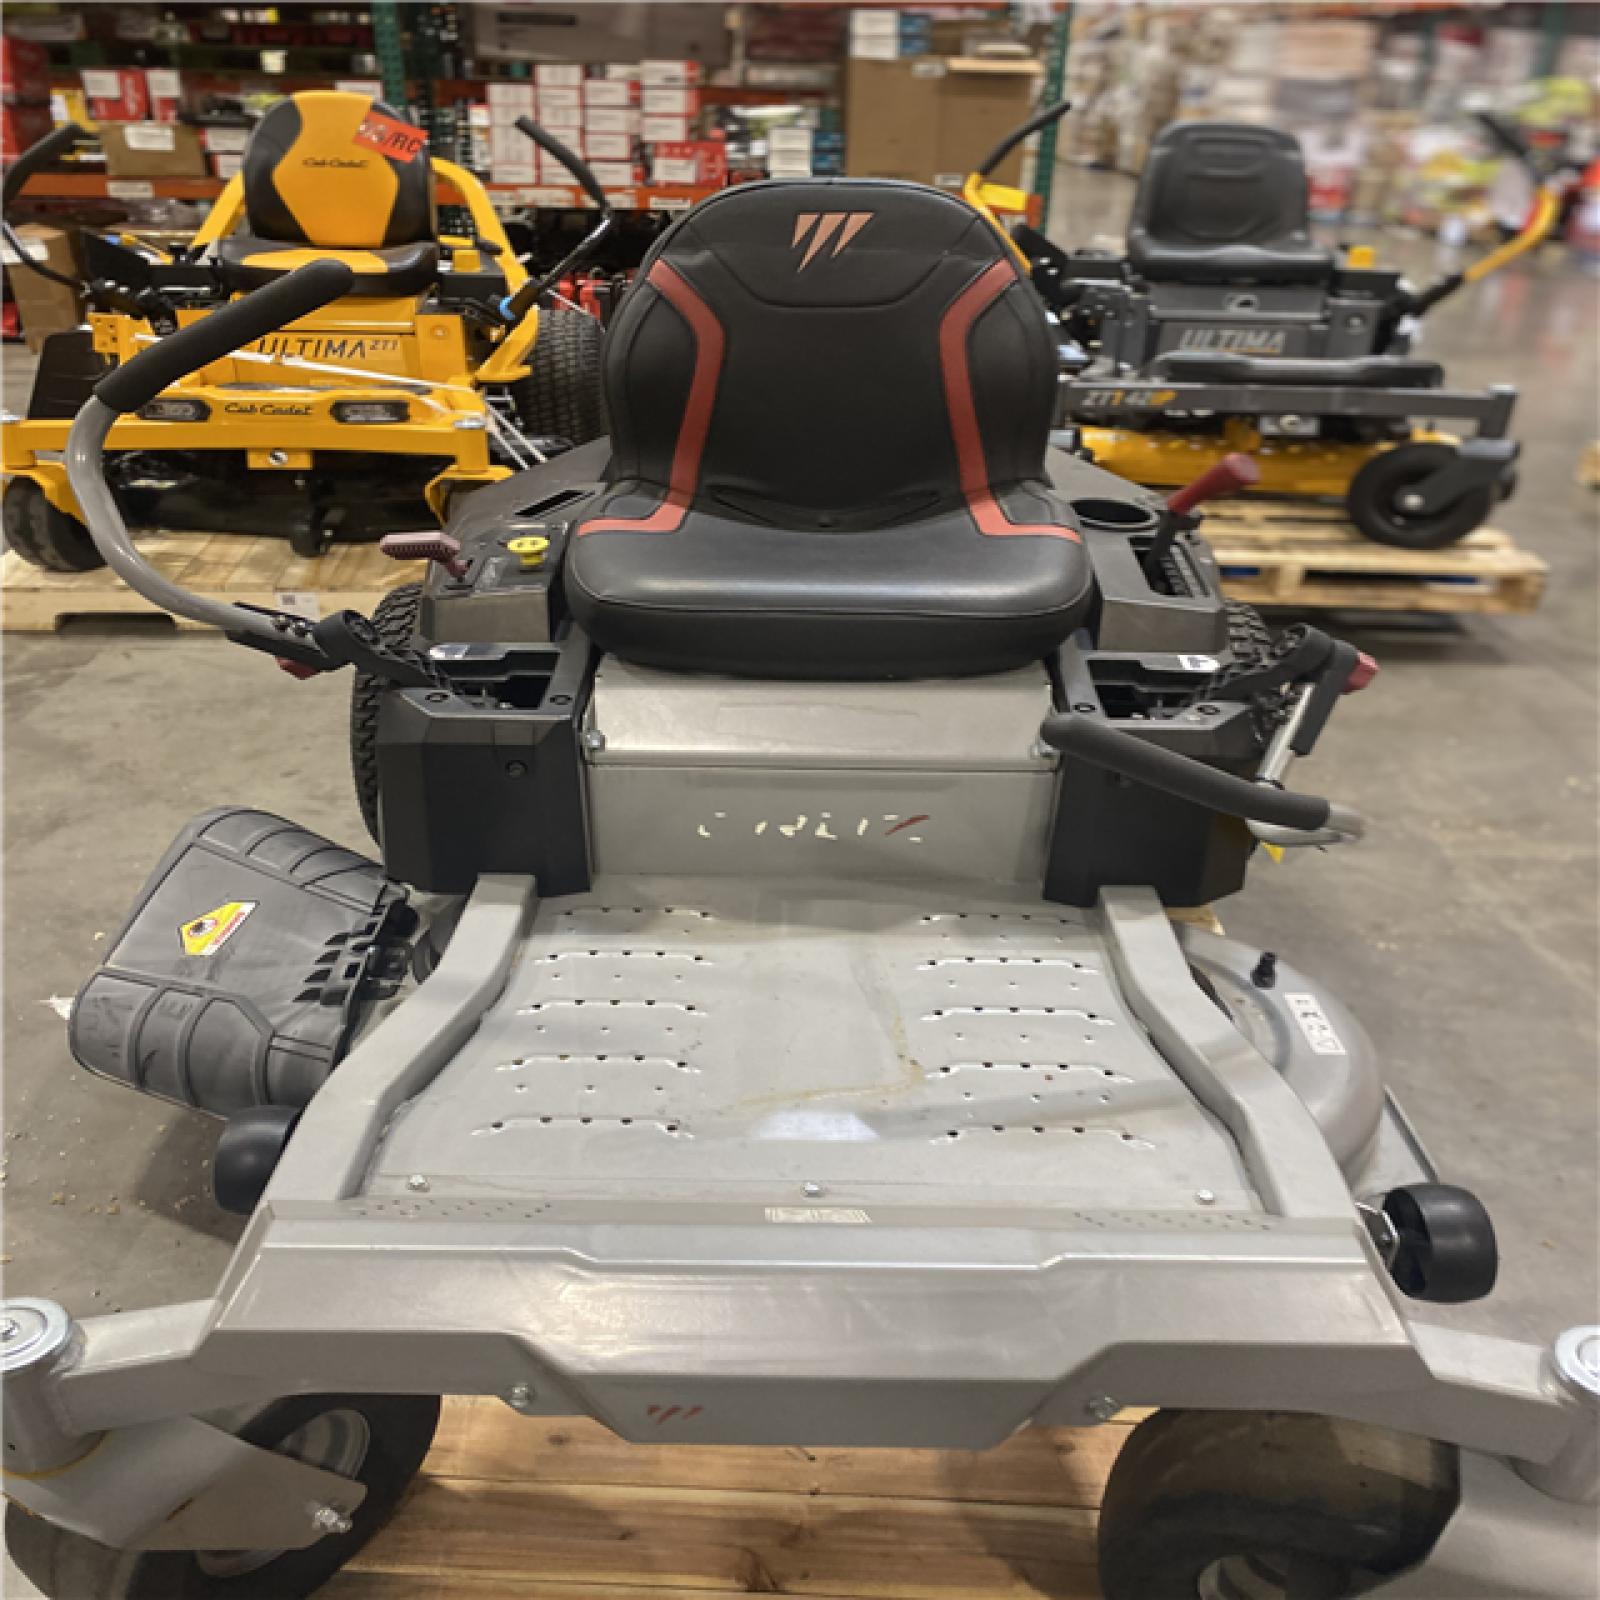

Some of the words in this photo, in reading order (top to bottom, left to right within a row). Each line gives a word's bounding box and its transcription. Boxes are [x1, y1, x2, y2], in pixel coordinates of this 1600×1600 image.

[257, 336, 366, 359] ULTIMA
[1180, 328, 1285, 352] ULTIMA
[224, 402, 257, 413] Cub
[259, 403, 313, 416] Cadet
